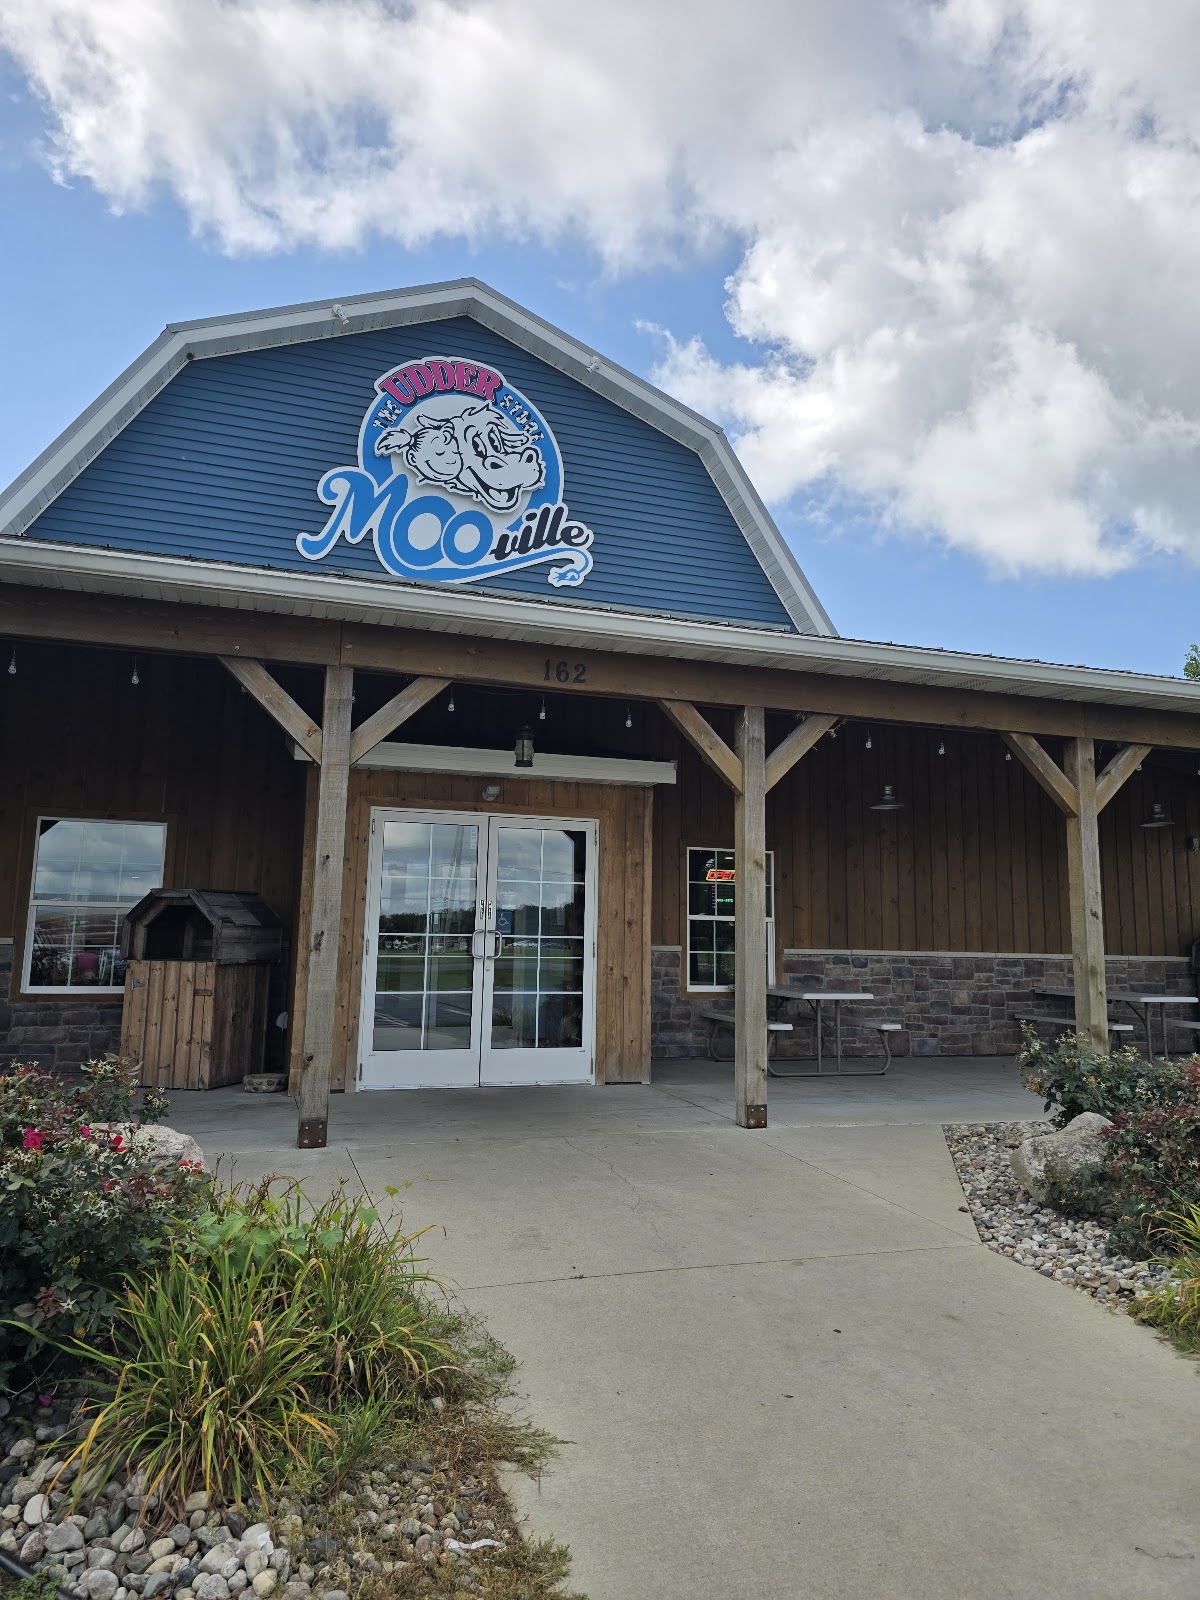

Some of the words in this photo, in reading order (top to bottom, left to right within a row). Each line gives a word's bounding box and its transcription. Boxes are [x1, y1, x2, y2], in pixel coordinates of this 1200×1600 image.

[379, 360, 503, 406] UDDER
[372, 399, 404, 430] THE
[544, 658, 586, 684] 162
